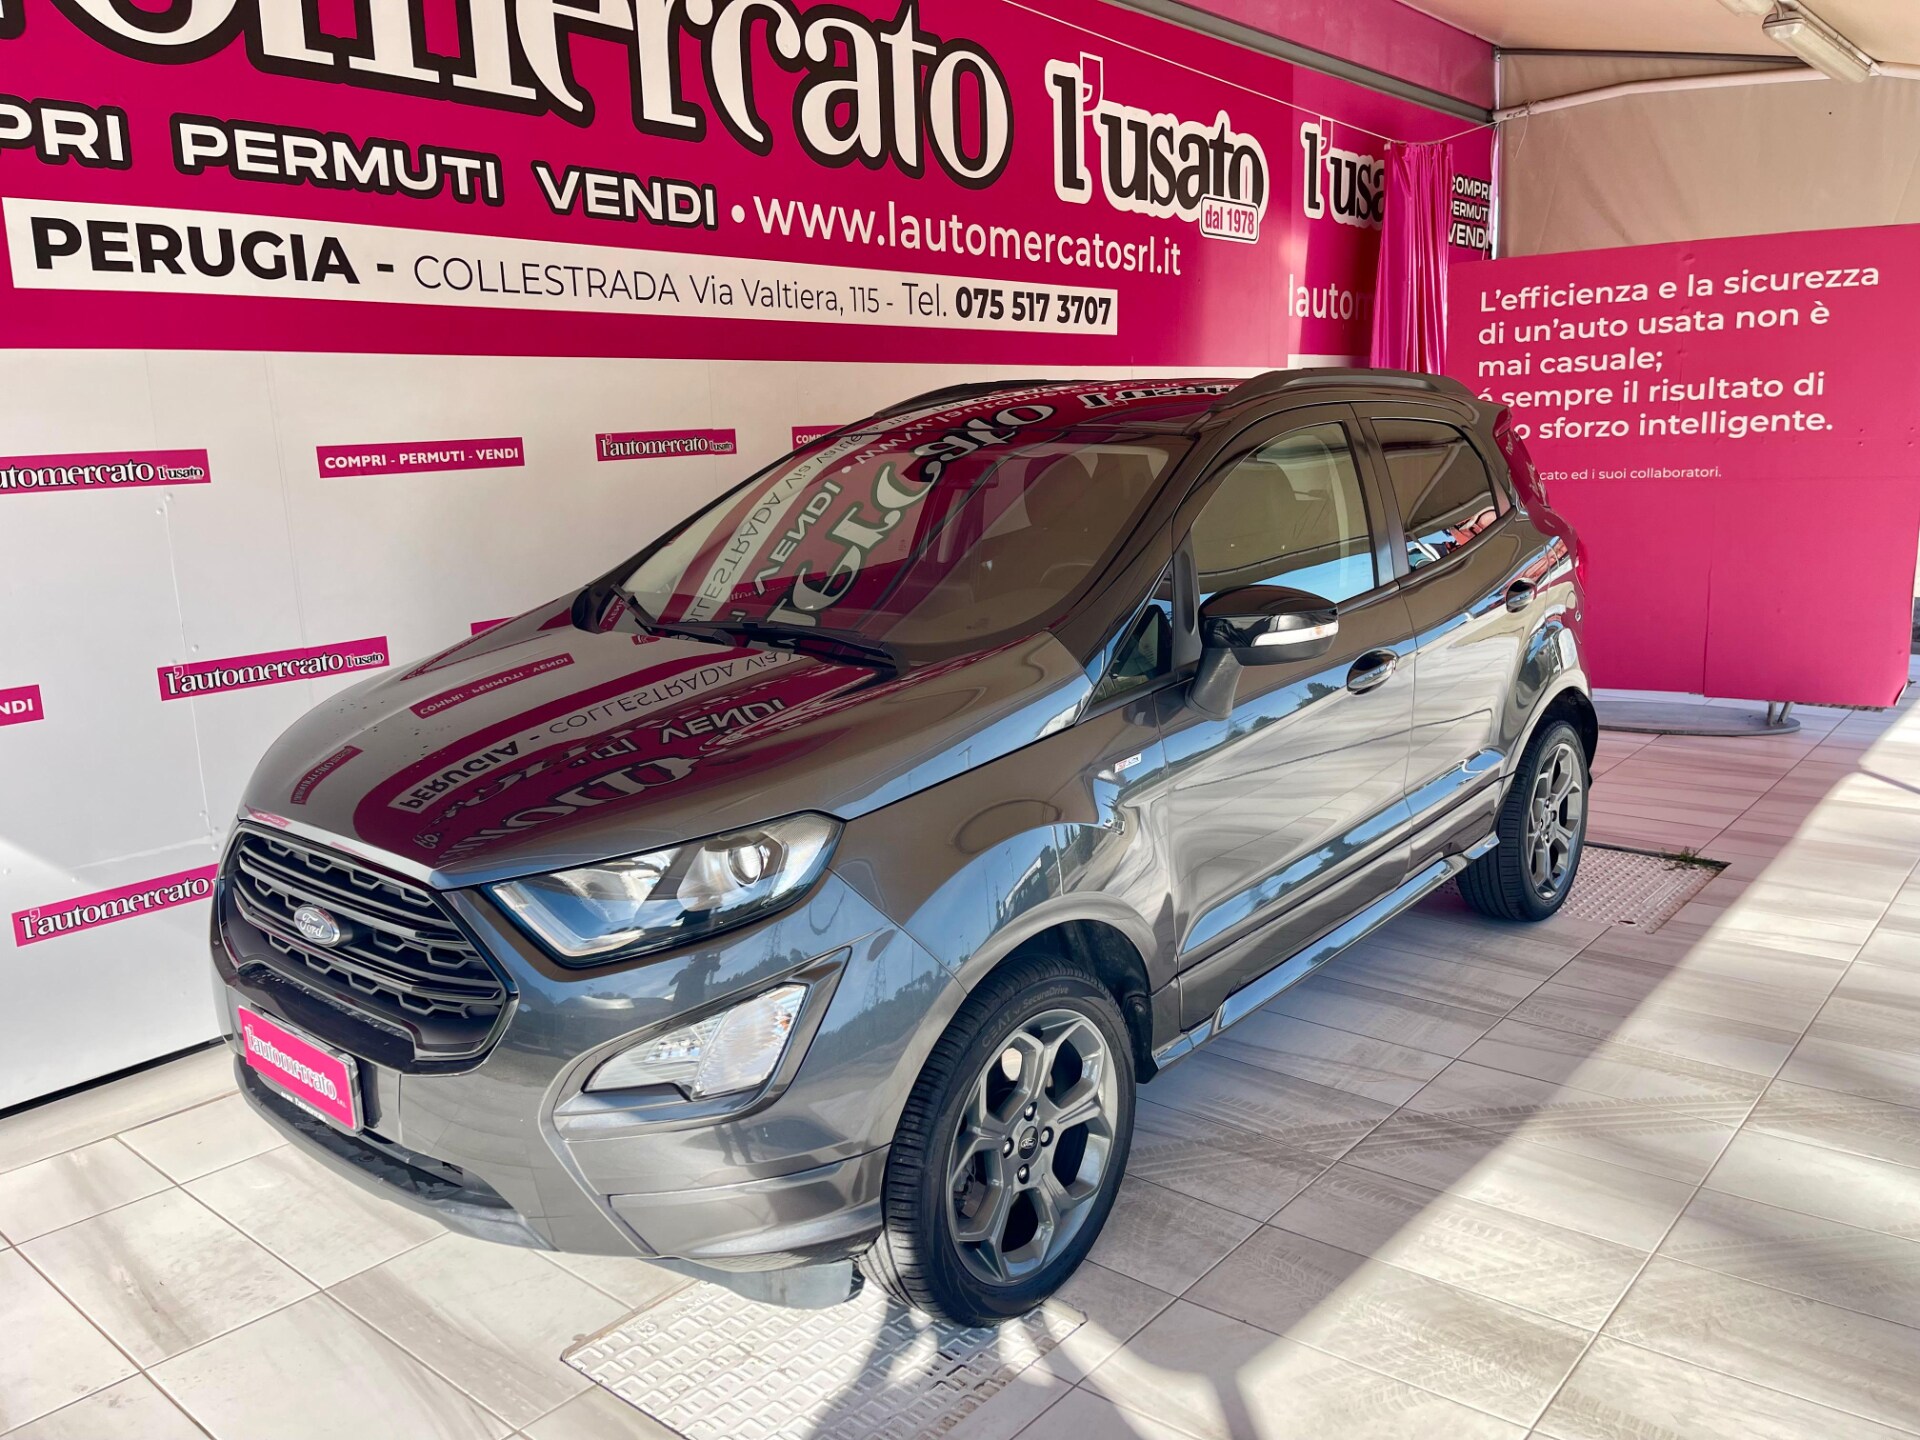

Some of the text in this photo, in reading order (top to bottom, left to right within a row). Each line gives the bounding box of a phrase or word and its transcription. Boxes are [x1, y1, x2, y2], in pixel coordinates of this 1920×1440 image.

[1047, 51, 1266, 212] l'usato
[179, 122, 498, 198] PERMUTI
[535, 166, 716, 225] VENDI
[753, 196, 1181, 275] www.lautomercatosrl.it
[1205, 205, 1254, 235] dal 1978
[31, 216, 360, 285] PERUGIA
[413, 255, 679, 302] COLLESTRADA
[689, 273, 733, 305] Via
[741, 278, 844, 316] Valtiera,
[849, 286, 880, 313] 115
[902, 282, 947, 317] Tel.
[955, 286, 1005, 319] 075
[1011, 291, 1050, 322] 517
[1056, 294, 1112, 325] 3707
[1480, 266, 1880, 312] L'efficienza e la sicurezza
[1478, 300, 1830, 345] di un'auto usata non è
[1478, 347, 1663, 378] mai casuale;
[1501, 387, 1613, 411] sempre
[1623, 380, 1638, 404] il
[1649, 375, 1783, 402] risultato
[1793, 371, 1825, 396] di
[1539, 417, 1630, 439] sforzo
[1639, 409, 1833, 438] intelligente.
[324, 454, 386, 469] COMPRI
[399, 451, 464, 464] PERMUTI
[476, 448, 519, 460] VENDI
[600, 434, 709, 457] l'automercato
[1571, 469, 1588, 480] ed
[1592, 468, 1595, 479] i
[1599, 468, 1626, 479] suoi
[1630, 466, 1722, 479] collaboratori.
[20, 877, 210, 939] l'automercato
[300, 912, 325, 938] Ford
[982, 1012, 1011, 1048] CEAT
[244, 1024, 337, 1101] l'automercato
